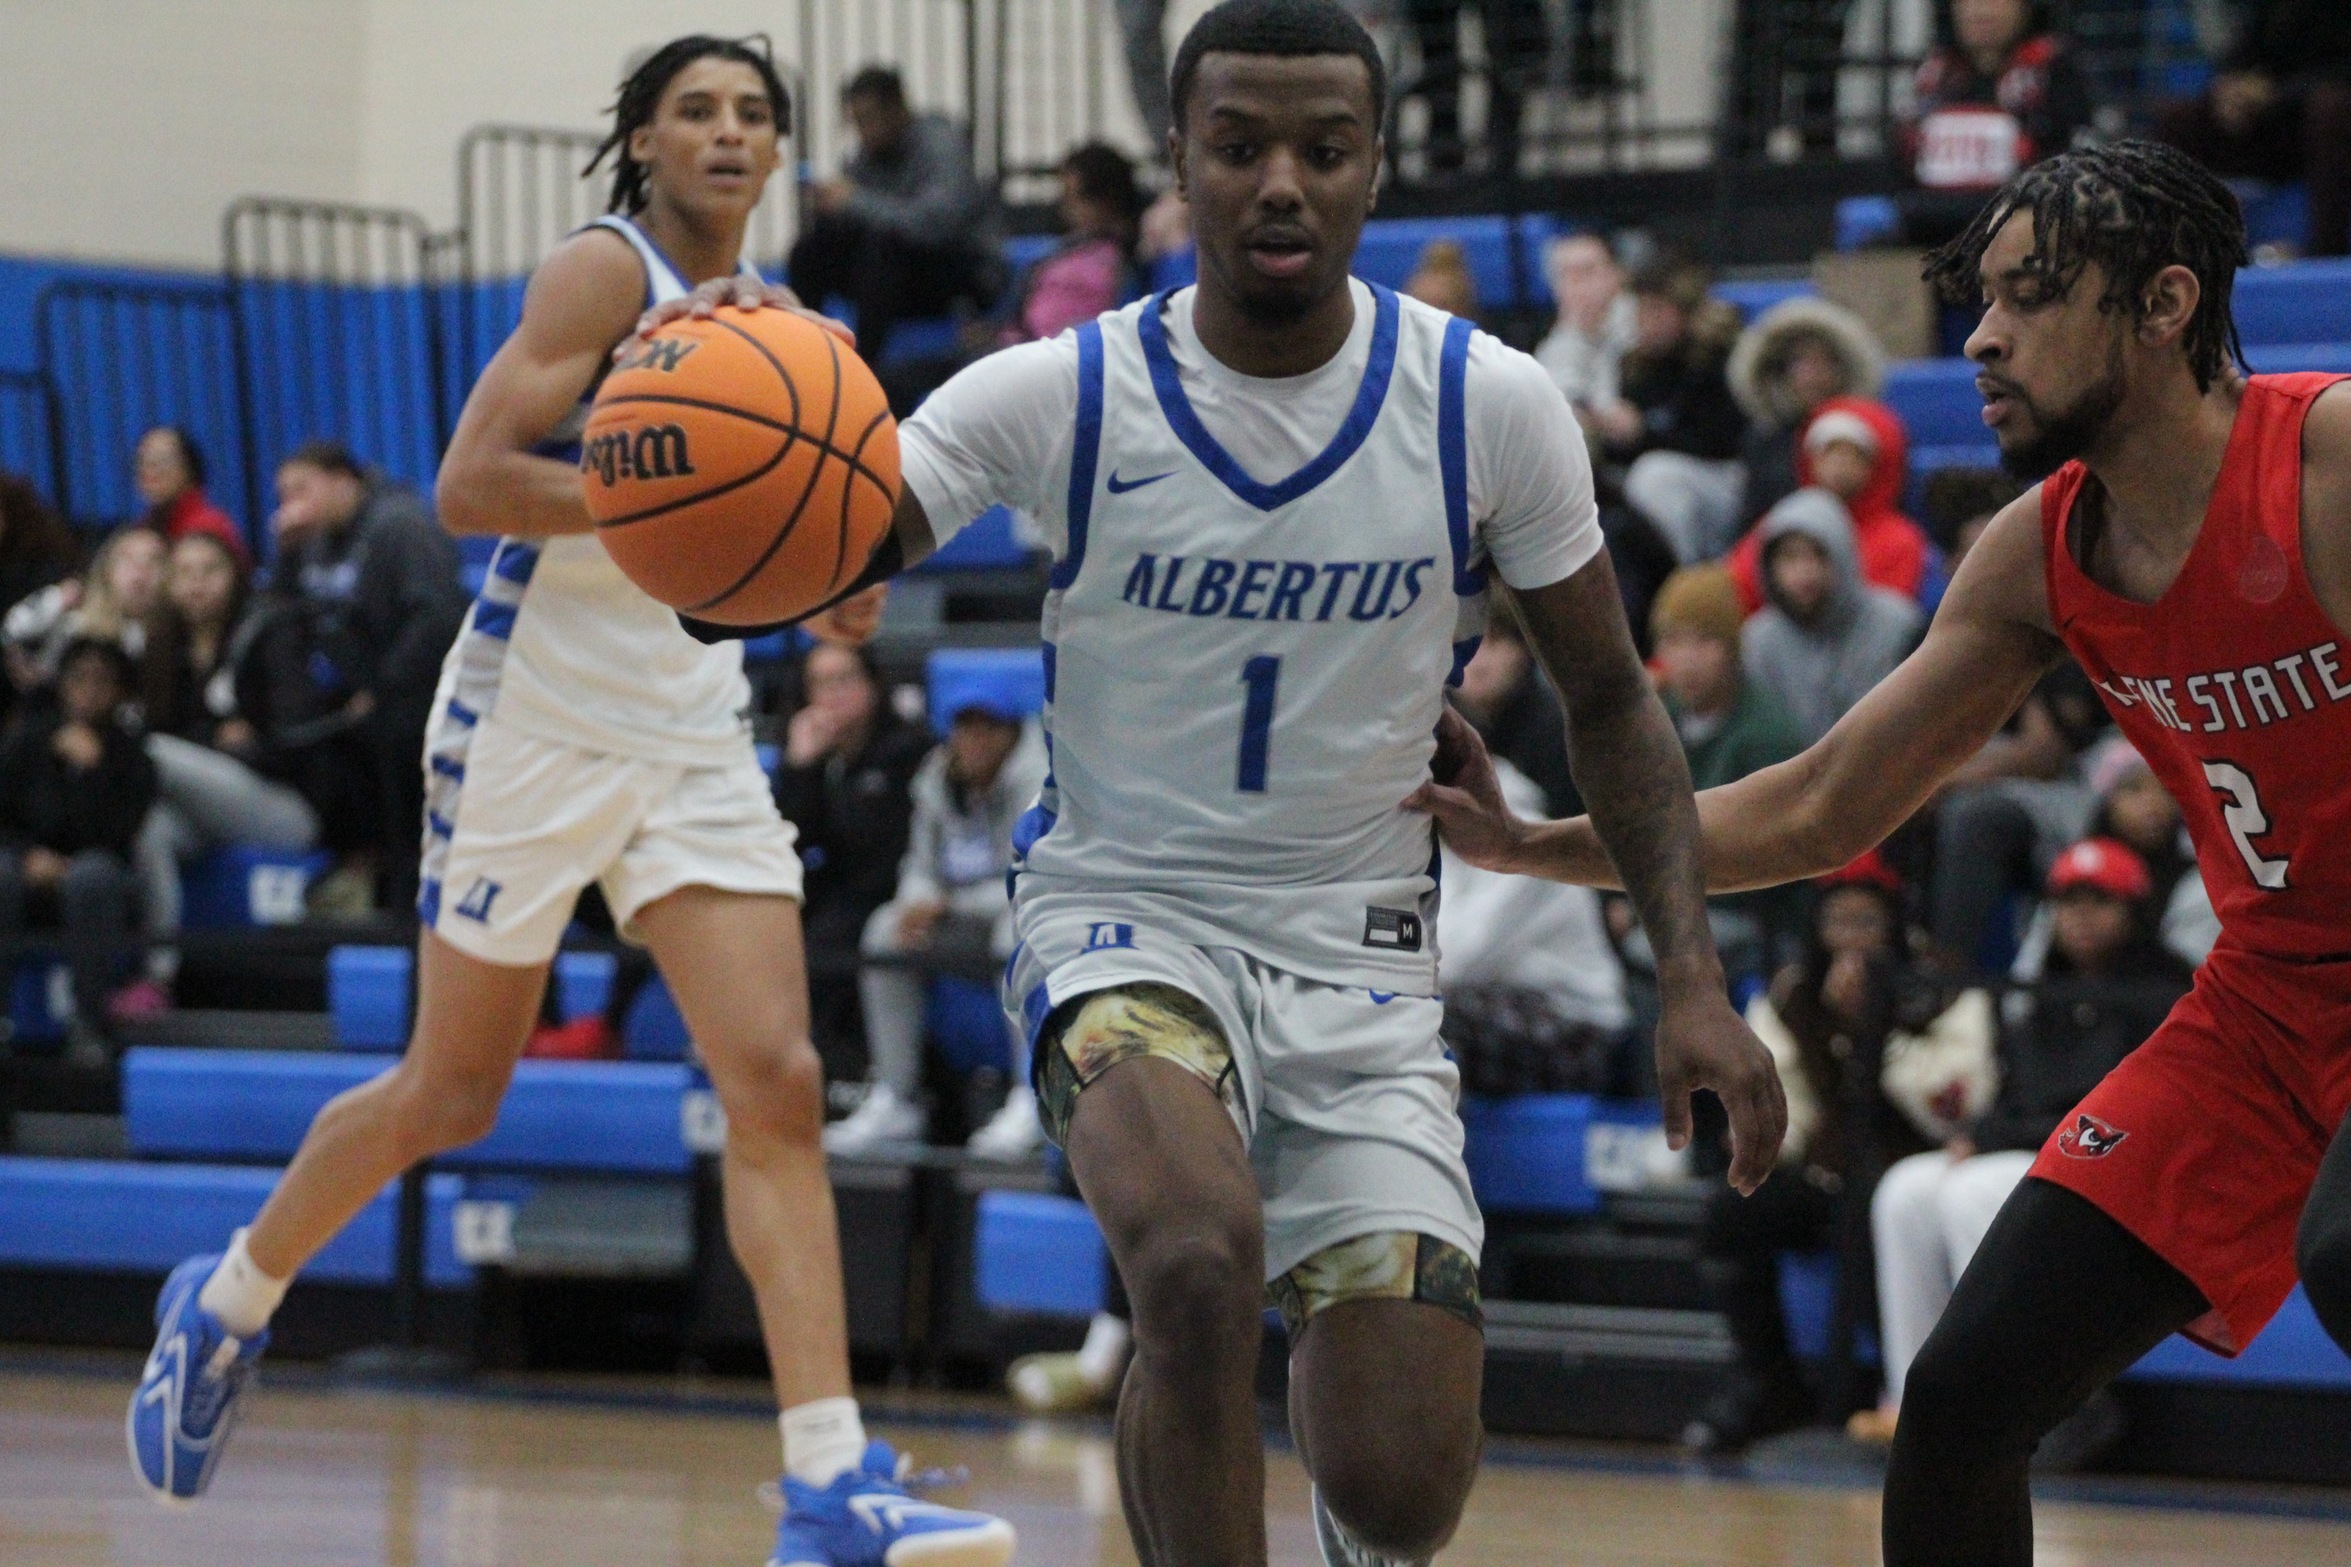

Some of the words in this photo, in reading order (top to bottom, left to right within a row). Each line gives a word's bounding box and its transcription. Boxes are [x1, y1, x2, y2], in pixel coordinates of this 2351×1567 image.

[1123, 553, 1435, 621] ALBERTUS
[1237, 655, 1280, 792] 1
[2187, 642, 2351, 732] STATE
[2201, 759, 2290, 889] 2
[1402, 922, 1413, 939] M
